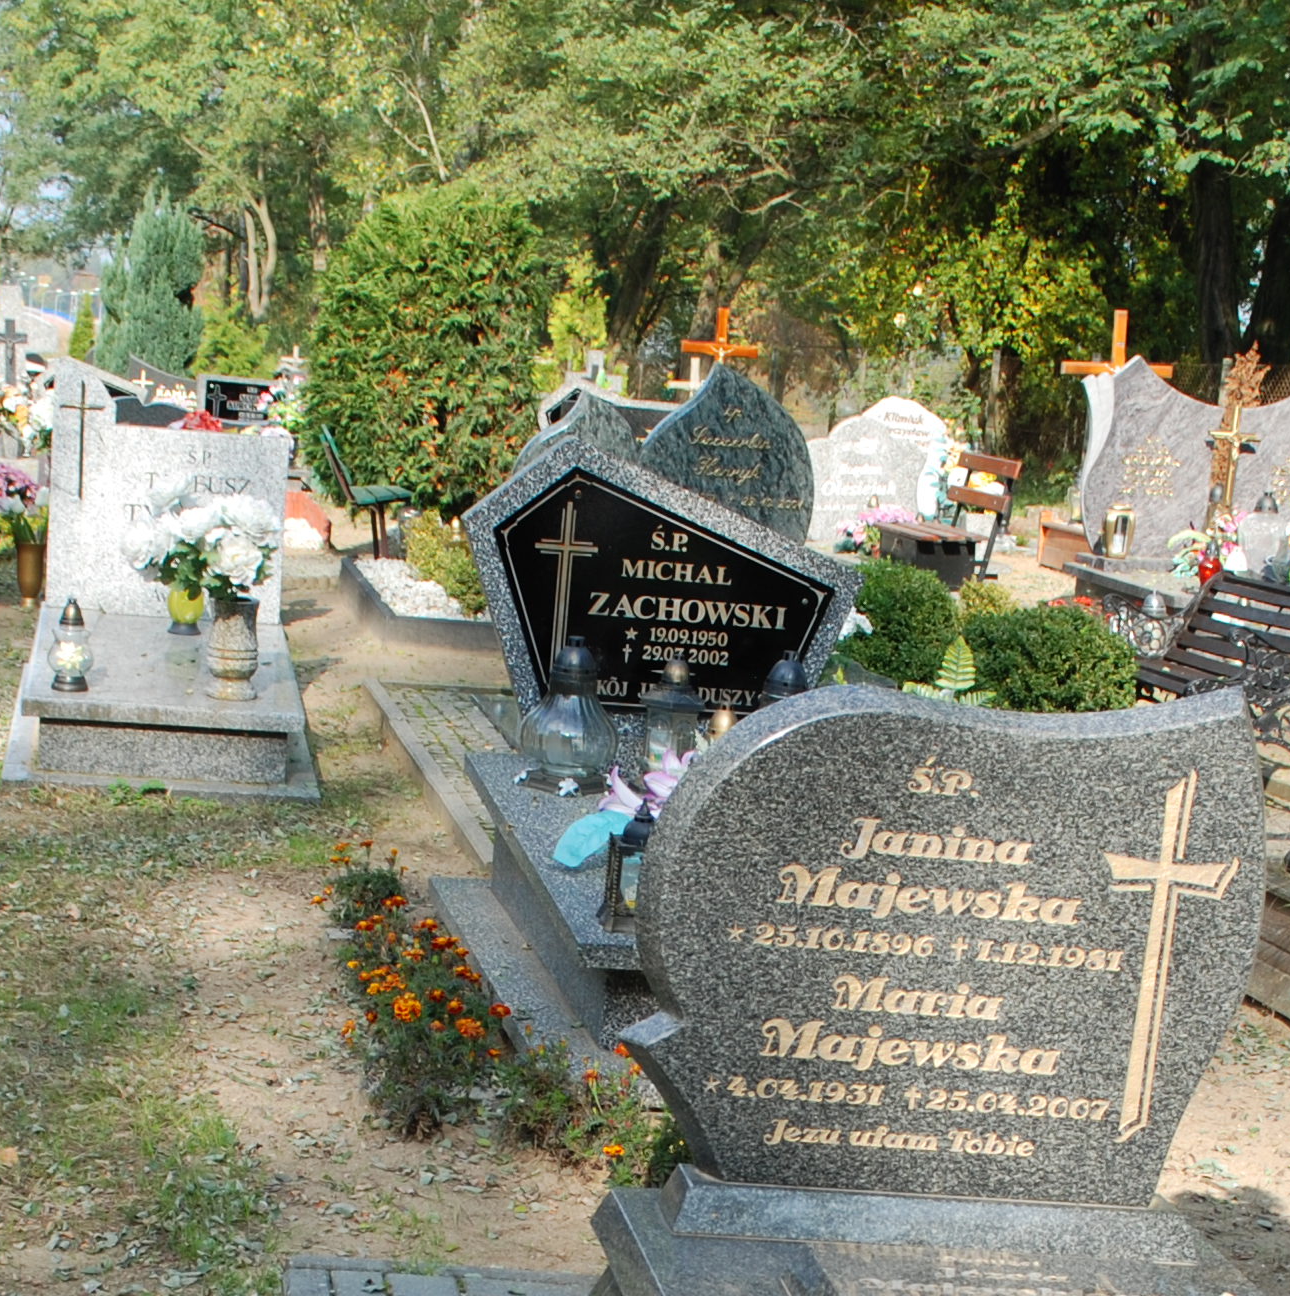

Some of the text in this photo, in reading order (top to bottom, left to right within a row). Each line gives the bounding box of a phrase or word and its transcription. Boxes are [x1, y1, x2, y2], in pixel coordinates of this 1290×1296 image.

[587, 591, 788, 631] ZACHOWSKI
[641, 644, 730, 667] 29.072002
[649, 626, 729, 648] 19.09.1950
[698, 687, 756, 706] DUSZY
[839, 815, 1035, 867] Janina
[775, 861, 1084, 927] Majewska
[753, 922, 1125, 973] 25.10.1896 1.12.1981
[831, 972, 1006, 1022] Maria
[757, 1016, 1063, 1077] Majewska
[726, 1074, 1111, 1122] 4.04.1931 25.04.2007
[762, 1118, 1036, 1158] Jezu ufam Tobie
